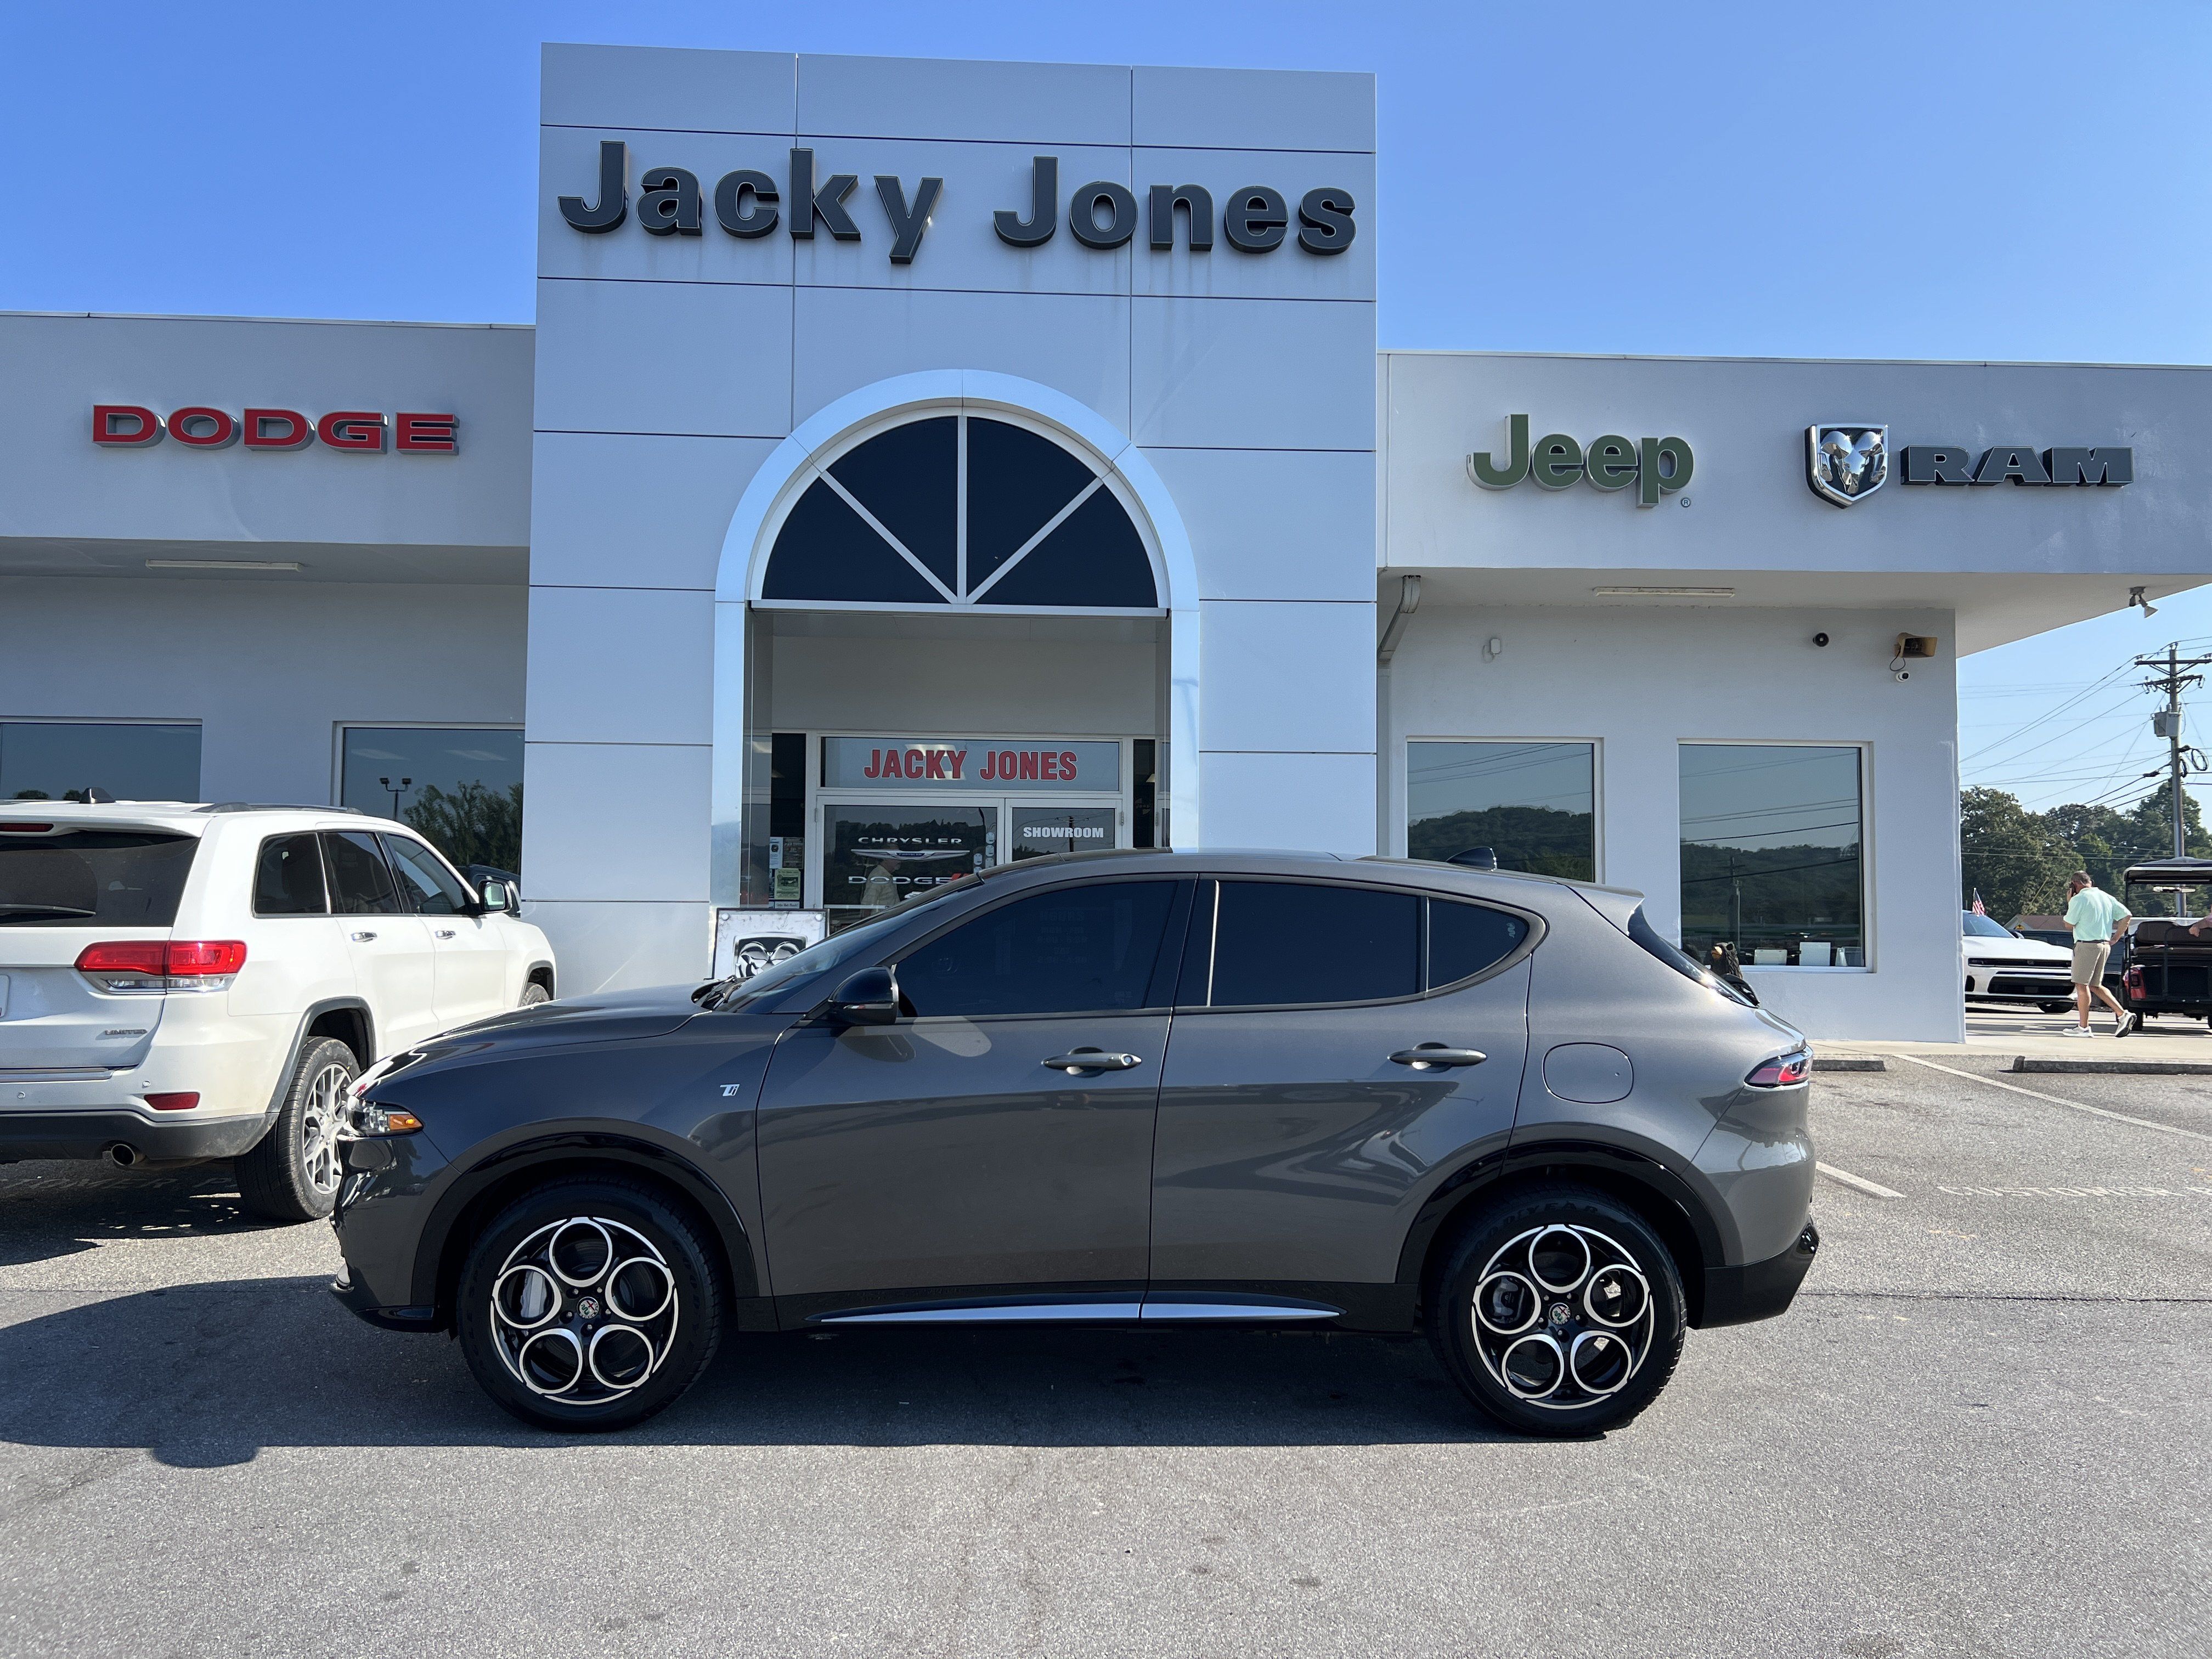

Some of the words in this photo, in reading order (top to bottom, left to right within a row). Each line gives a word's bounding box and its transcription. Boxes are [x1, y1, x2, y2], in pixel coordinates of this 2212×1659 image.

[556, 140, 944, 265] Jacky
[992, 156, 1357, 255] Jones
[93, 404, 460, 456] DODGE
[1466, 414, 1695, 508] Jeep
[1900, 445, 2135, 488] RAM
[864, 748, 968, 780] JACKY
[979, 751, 1079, 782] JONES
[857, 837, 963, 845] CHRYSLER
[1023, 825, 1104, 839] SHOWROOM
[848, 876, 952, 885] DODGE
[1936, 1185, 2186, 1197] CUSTOMER
